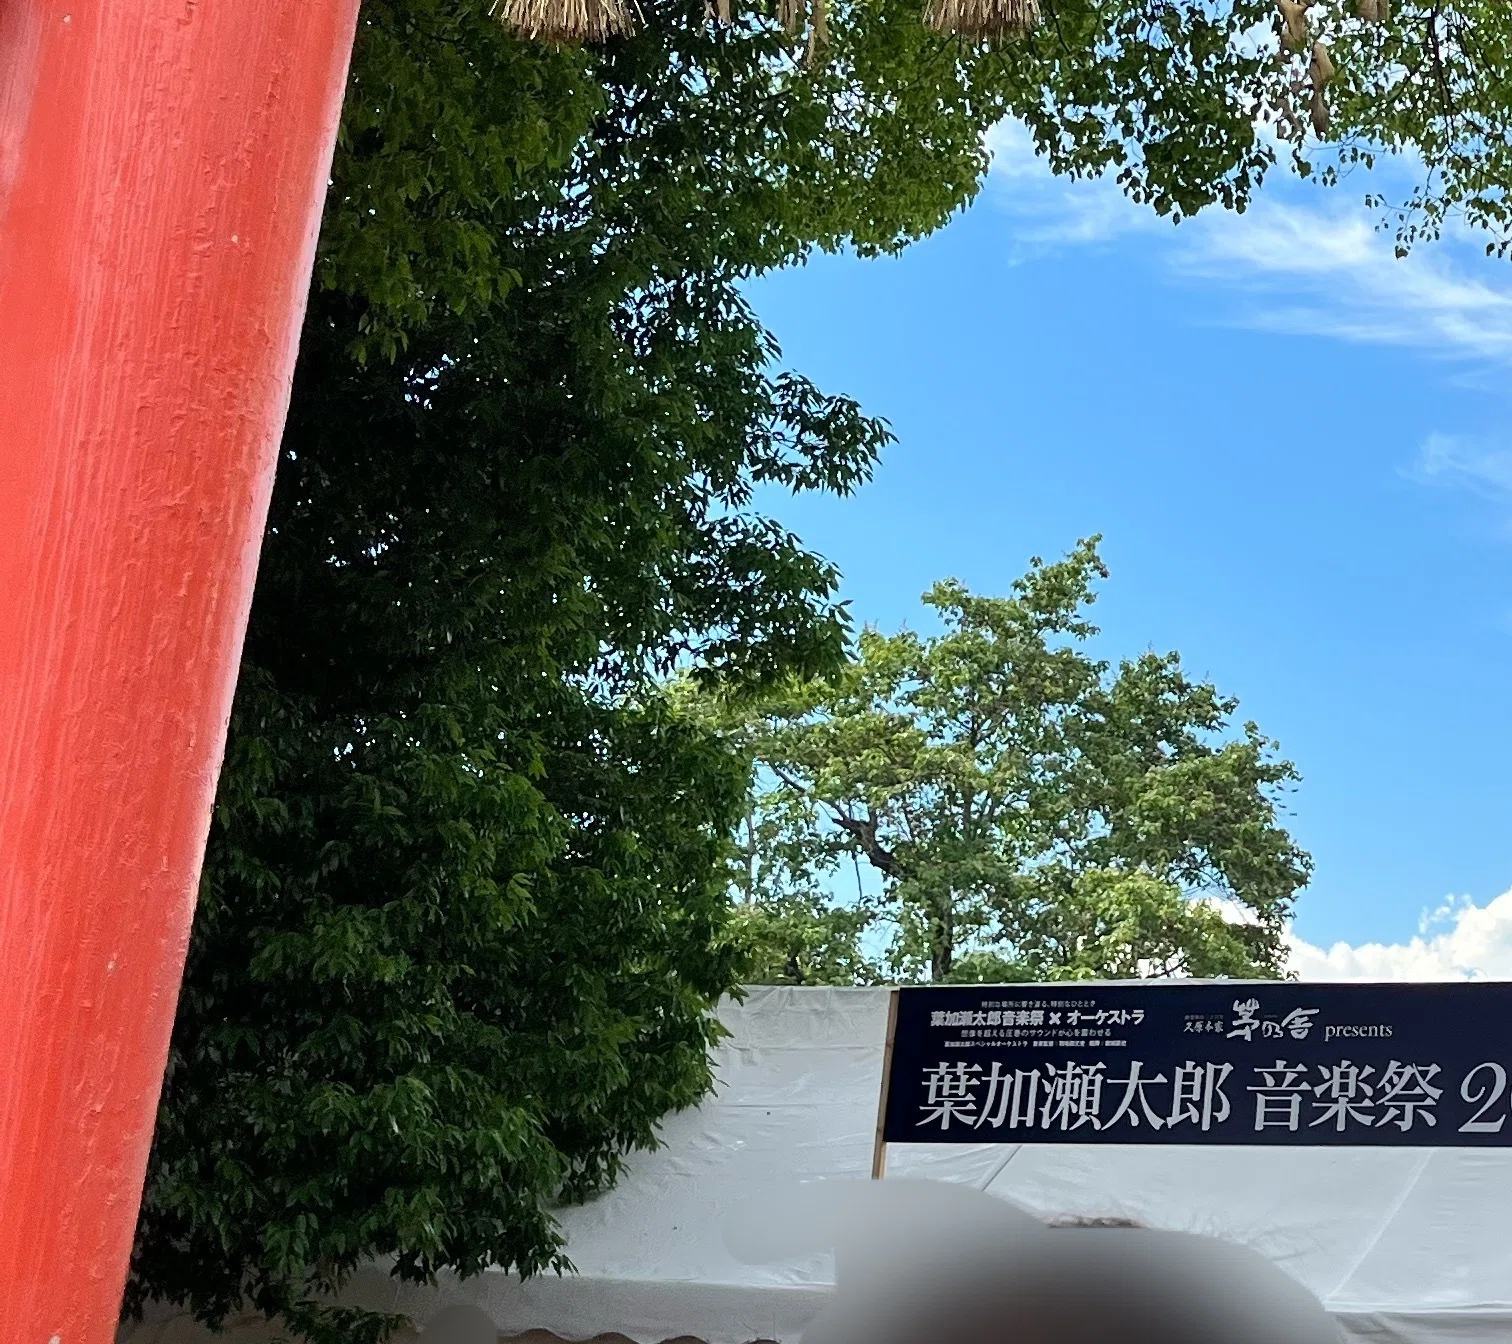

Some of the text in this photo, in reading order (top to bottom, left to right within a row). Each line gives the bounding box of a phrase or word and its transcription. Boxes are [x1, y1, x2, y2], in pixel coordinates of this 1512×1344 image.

[931, 1010, 1045, 1027] 葉加瀬太郎音楽祭
[1067, 1009, 1145, 1025] オーケストラ
[1324, 1024, 1394, 1043] presents
[915, 1061, 1234, 1131] 葉加瀬太郎
[1246, 1060, 1444, 1132] 音楽祭
